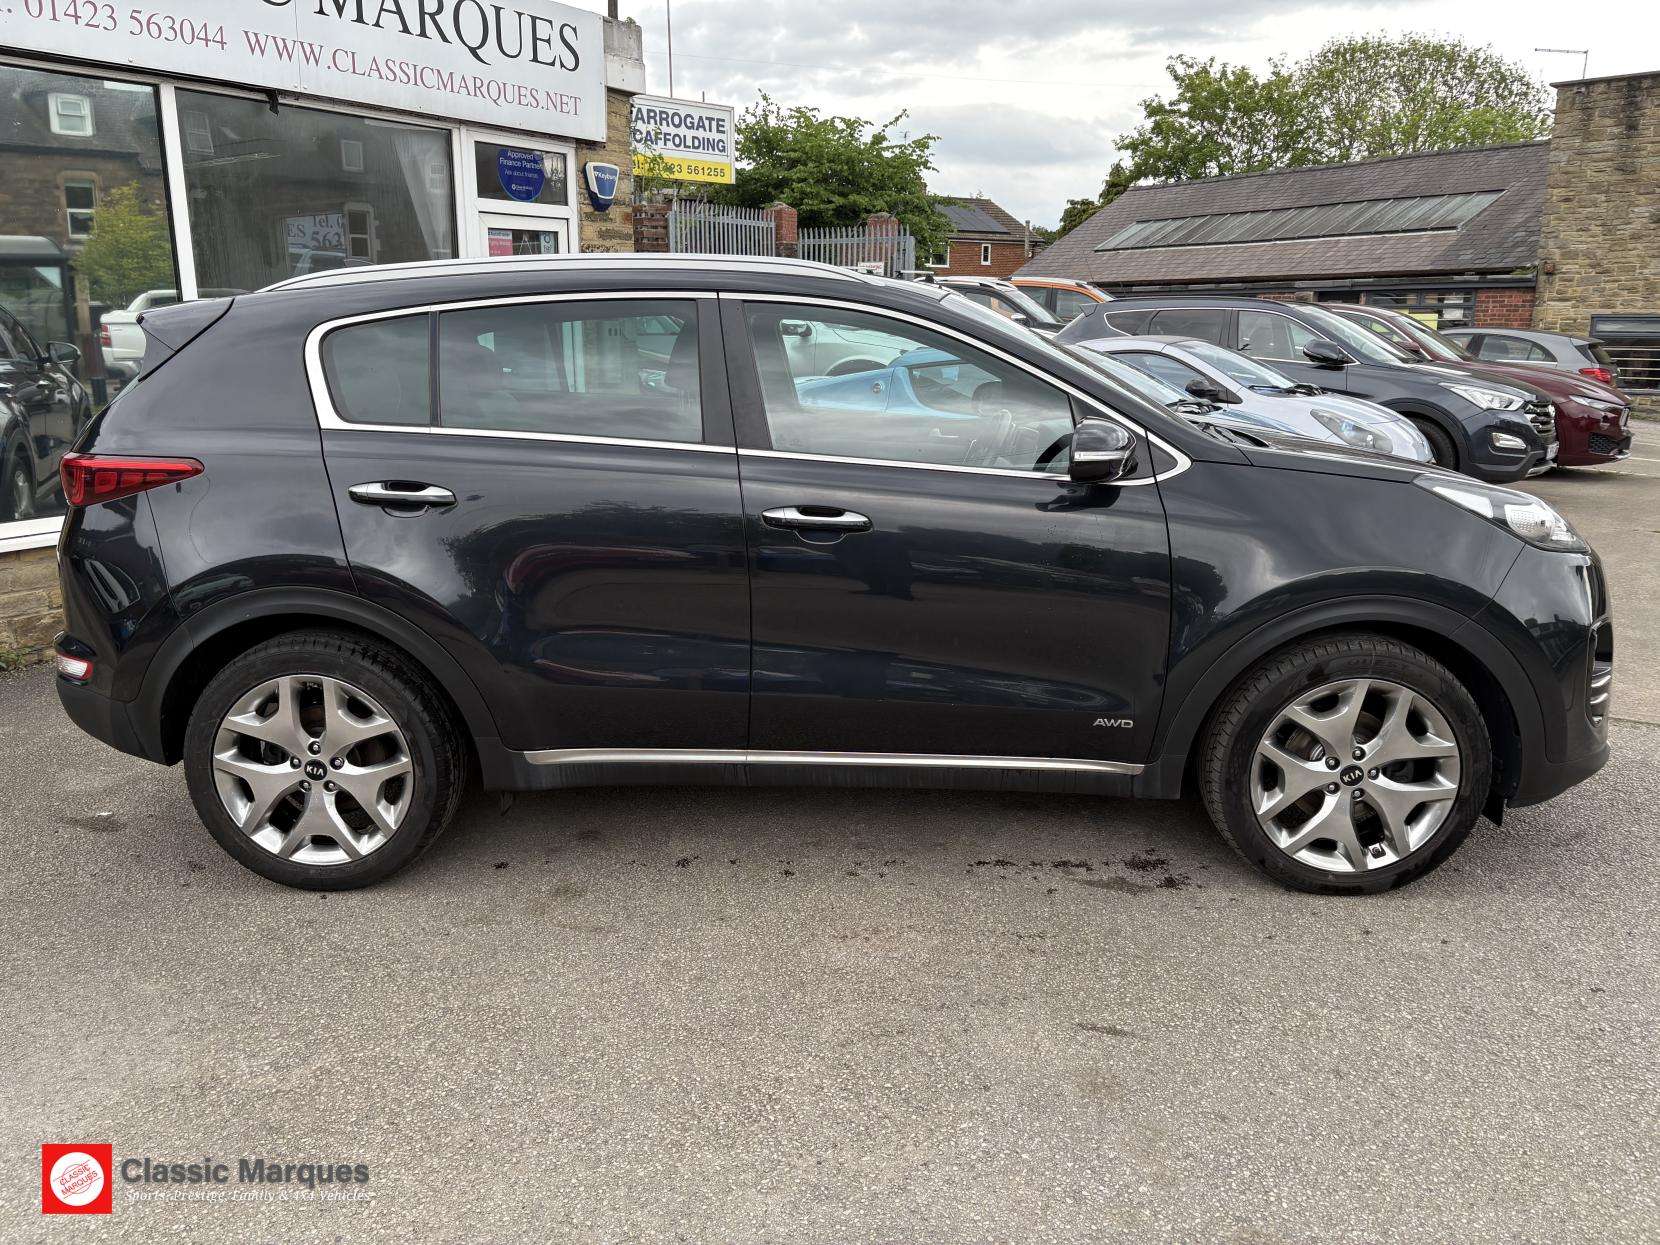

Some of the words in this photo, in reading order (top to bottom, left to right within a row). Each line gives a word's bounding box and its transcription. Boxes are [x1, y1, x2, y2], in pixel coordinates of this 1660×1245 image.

[24, 0, 119, 32] 01423
[129, 9, 229, 51] 563044
[241, 29, 583, 117] WWW.CLASSICMARQUES.NET
[633, 106, 727, 135] ARROGATE
[631, 128, 727, 154] CAFFOLDING
[499, 157, 522, 168] Finance
[686, 163, 726, 178] 561255
[1092, 718, 1134, 728] AWD
[306, 765, 324, 777] KIA
[1342, 769, 1362, 783] KIA
